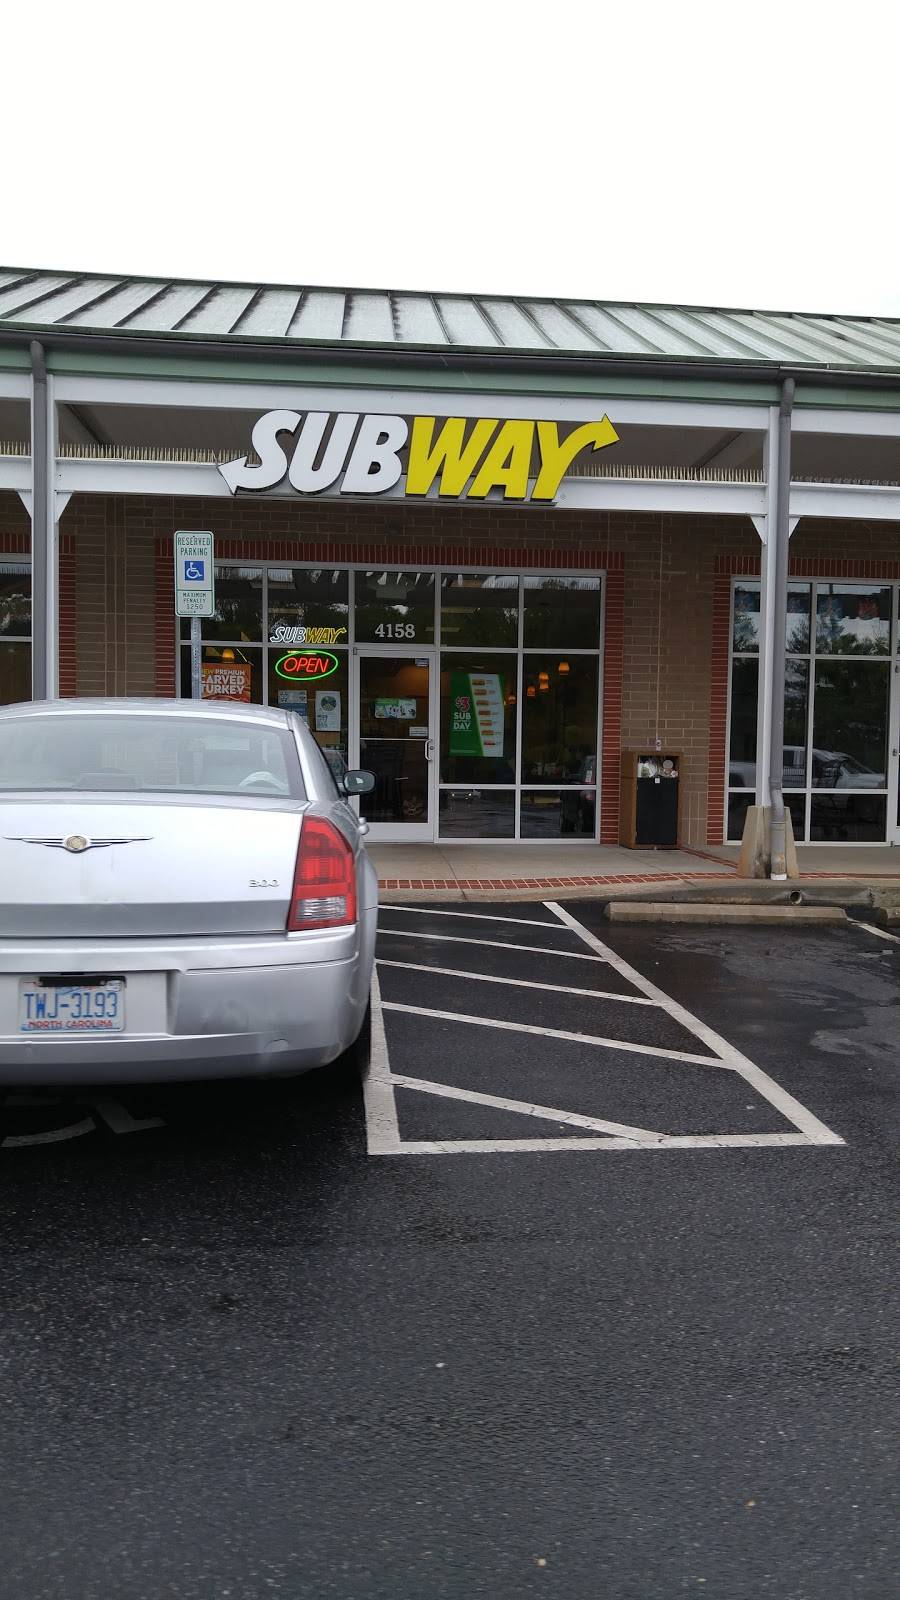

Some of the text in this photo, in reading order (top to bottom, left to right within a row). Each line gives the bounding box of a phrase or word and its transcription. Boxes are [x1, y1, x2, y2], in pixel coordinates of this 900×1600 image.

[218, 408, 620, 502] SUBWAY
[177, 536, 211, 546] RESERVED
[180, 547, 208, 556] PARKING
[270, 626, 347, 644] SUBWAY
[374, 623, 416, 639] 4158
[283, 657, 329, 673] OPEN
[200, 684, 245, 695] TURKEY
[453, 712, 472, 720] SUB
[453, 722, 471, 730] DAY
[23, 992, 118, 1019] TWJ-3193
[28, 1020, 113, 1029] NORTH CAROLINA
